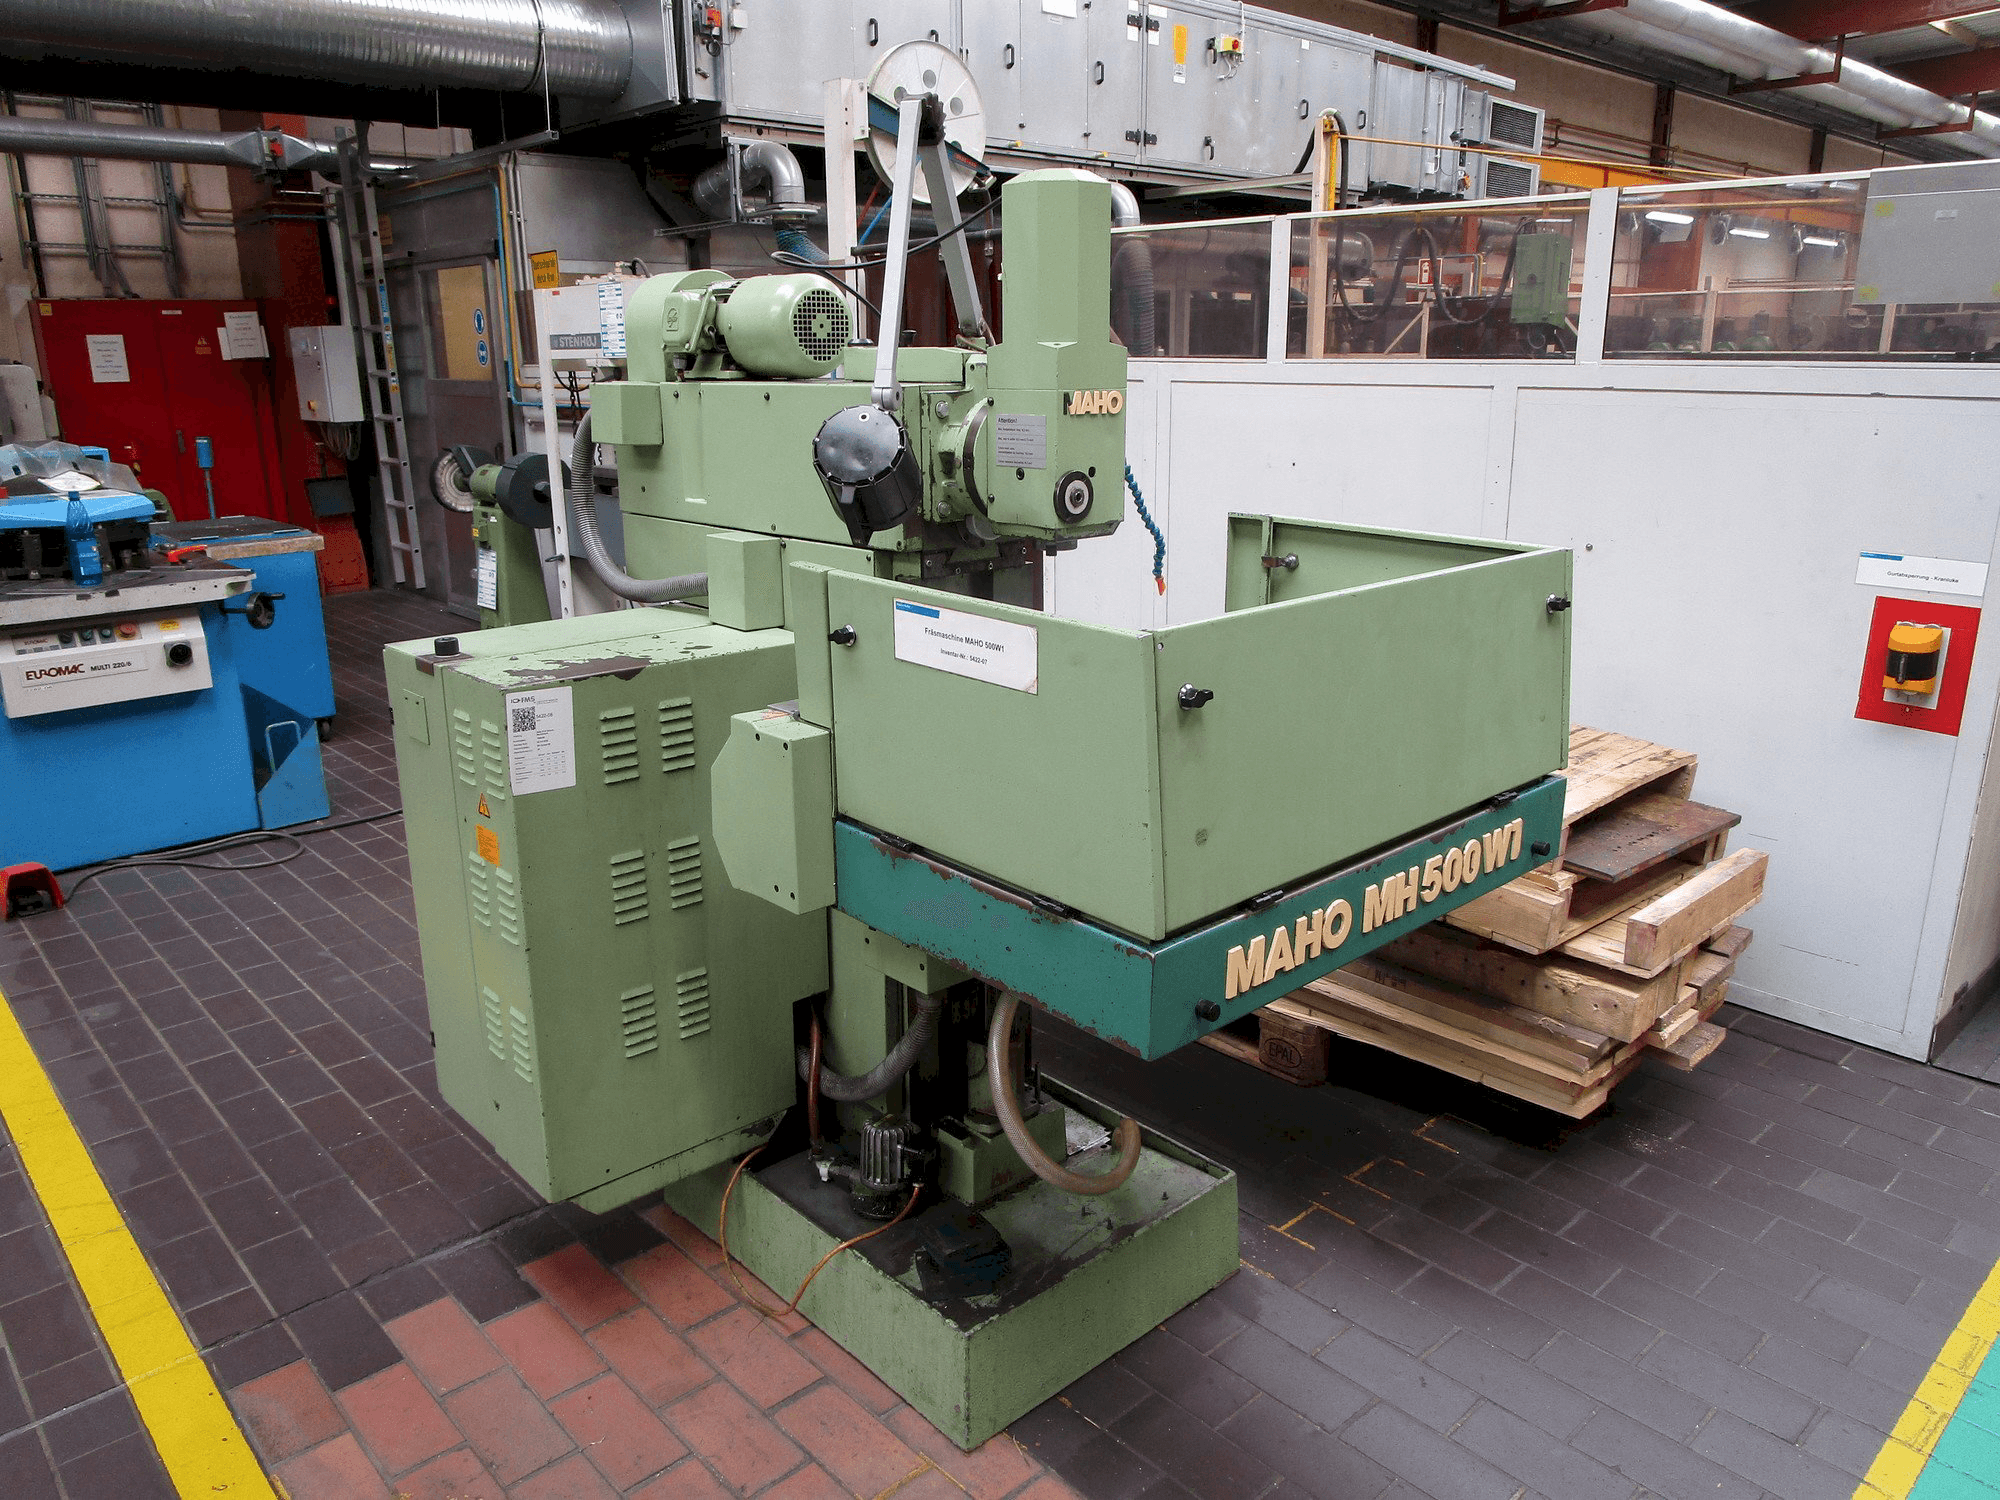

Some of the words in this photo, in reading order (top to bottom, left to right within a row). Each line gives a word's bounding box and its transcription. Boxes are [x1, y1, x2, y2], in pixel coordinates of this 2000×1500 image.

[1063, 390, 1123, 415] MAHO
[924, 627, 964, 642] Fräsmaschine
[964, 636, 984, 648] MAHO
[985, 641, 1005, 652] 500W1
[25, 663, 86, 681] EUROMAC
[90, 664, 111, 672] MULTI
[1225, 898, 1353, 1000] MAHO
